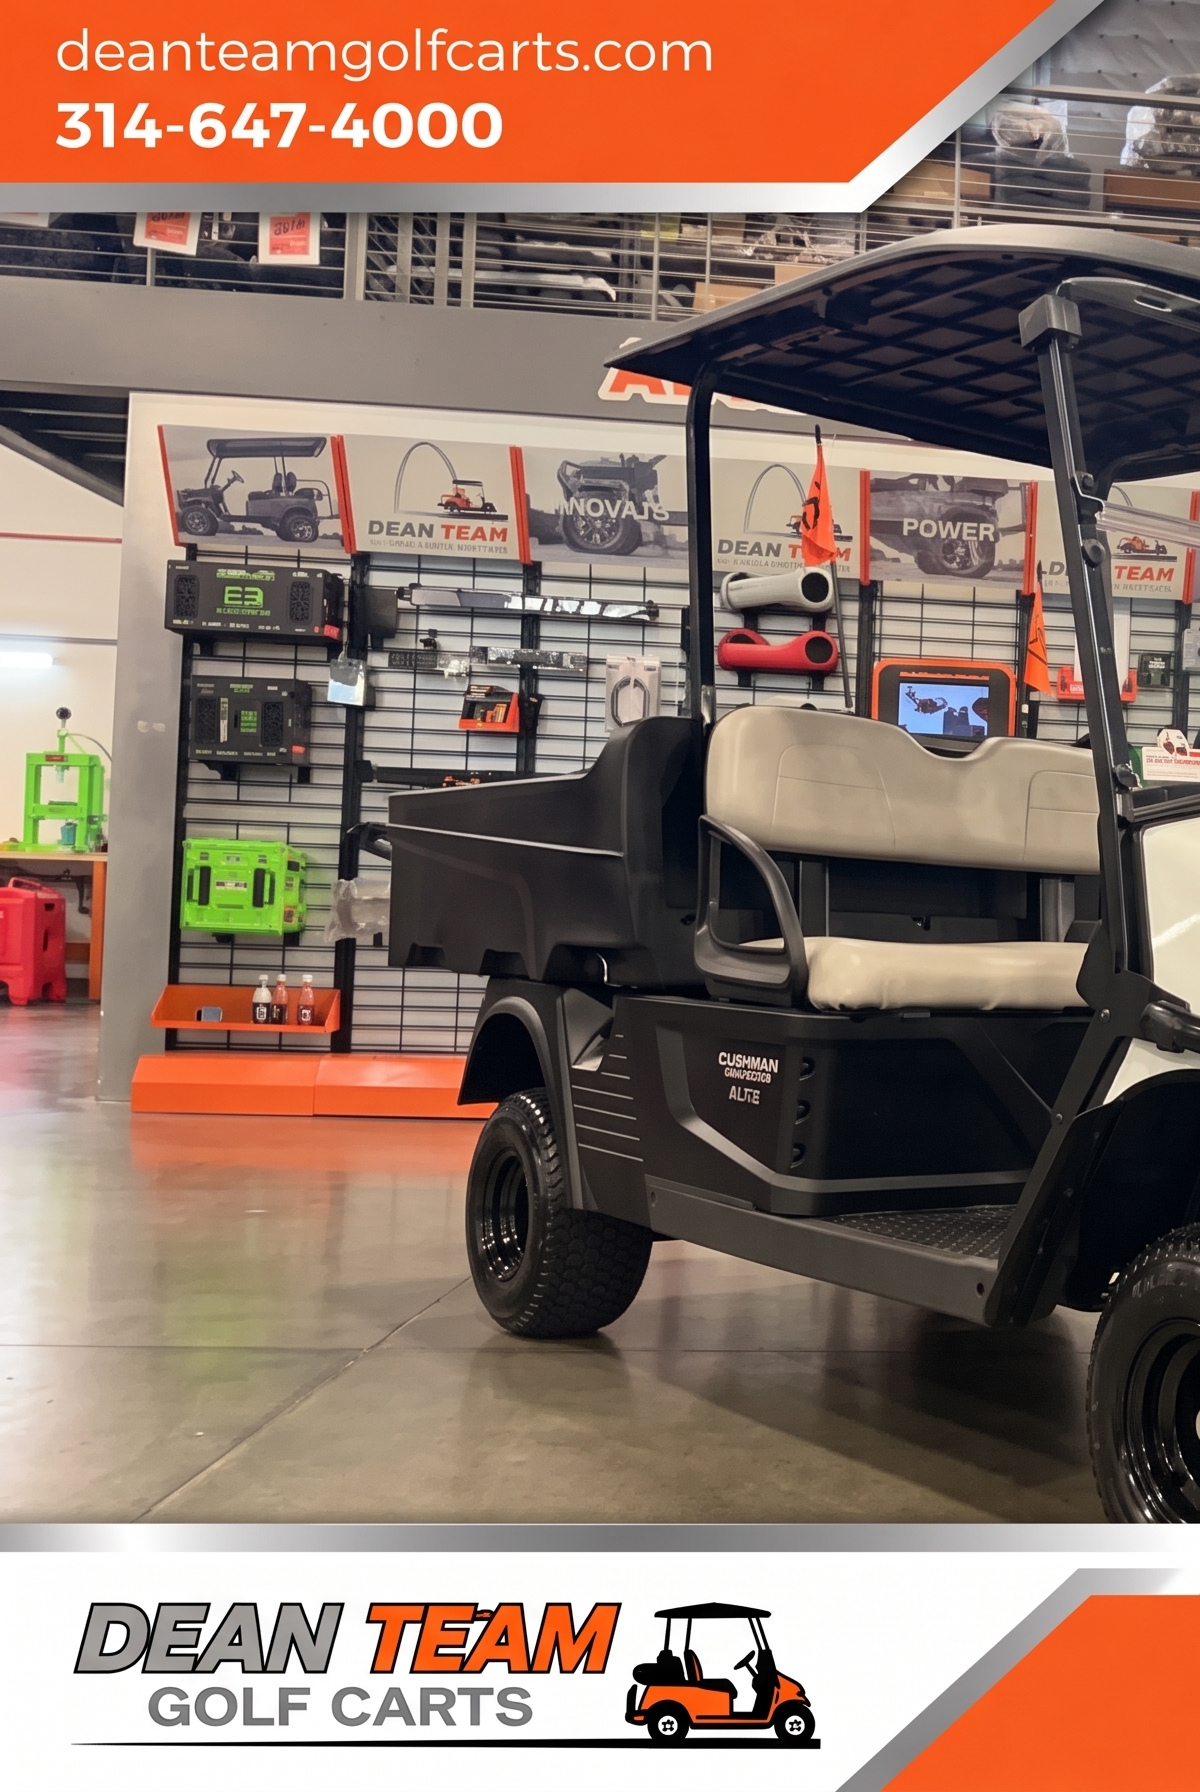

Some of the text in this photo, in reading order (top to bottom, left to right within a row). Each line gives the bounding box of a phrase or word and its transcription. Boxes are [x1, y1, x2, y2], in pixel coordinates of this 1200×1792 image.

[368, 520, 508, 543] DEAN TEAM
[902, 517, 995, 542] POWER
[717, 539, 852, 562] DEAN TM
[1114, 565, 1175, 582] TEAM
